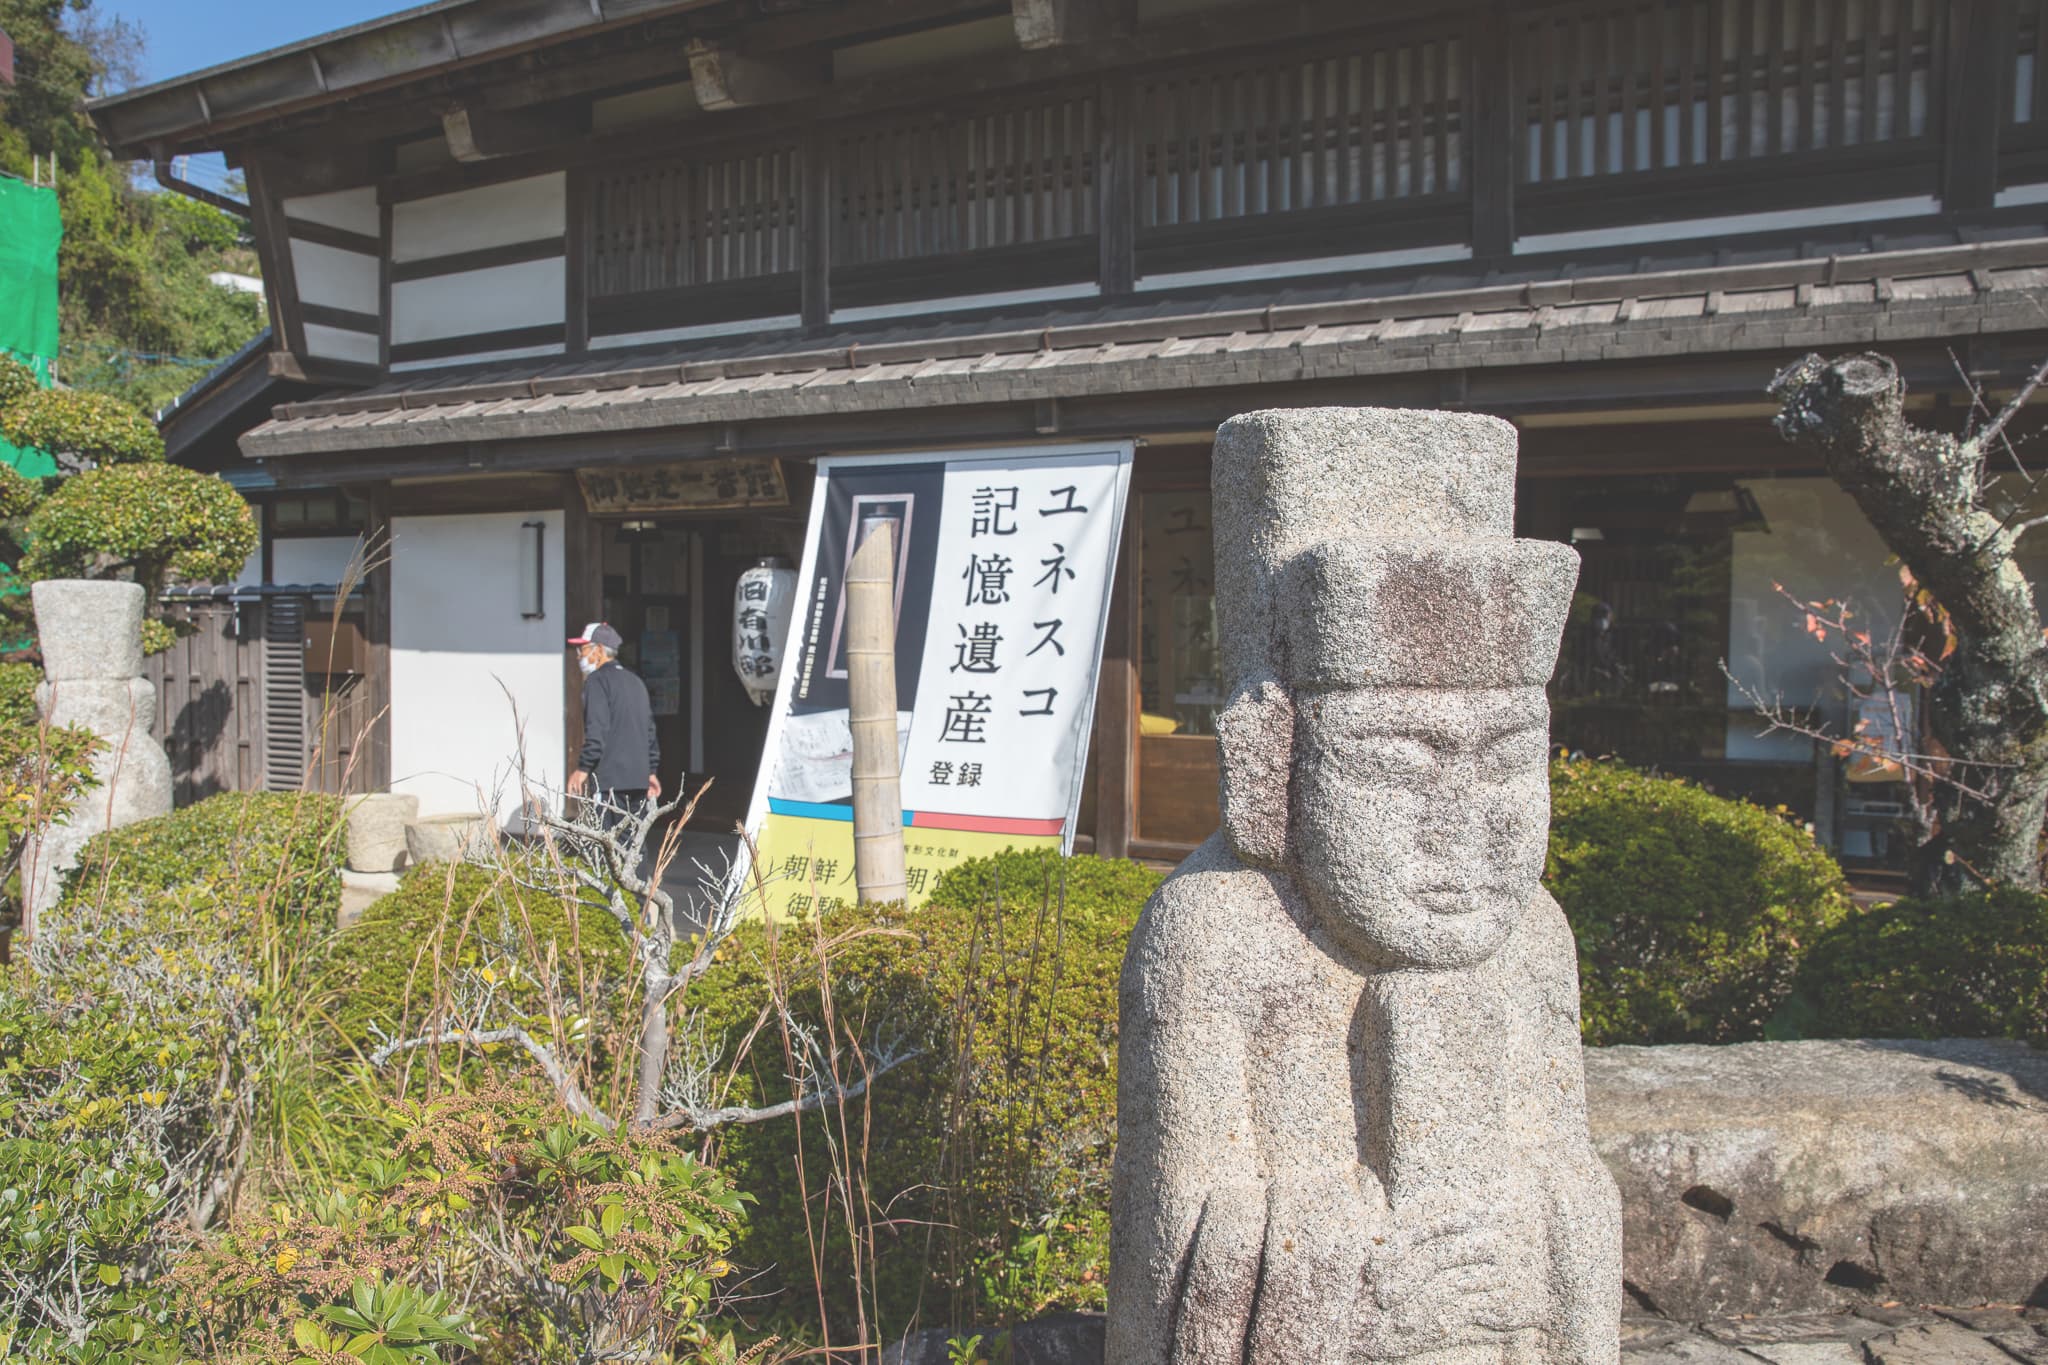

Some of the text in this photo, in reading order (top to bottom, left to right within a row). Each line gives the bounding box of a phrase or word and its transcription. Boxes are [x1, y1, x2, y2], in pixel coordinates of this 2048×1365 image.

[937, 486, 1020, 744] 記憶遺産
[1019, 485, 1089, 718] ユネスコ
[928, 760, 983, 788] 登録
